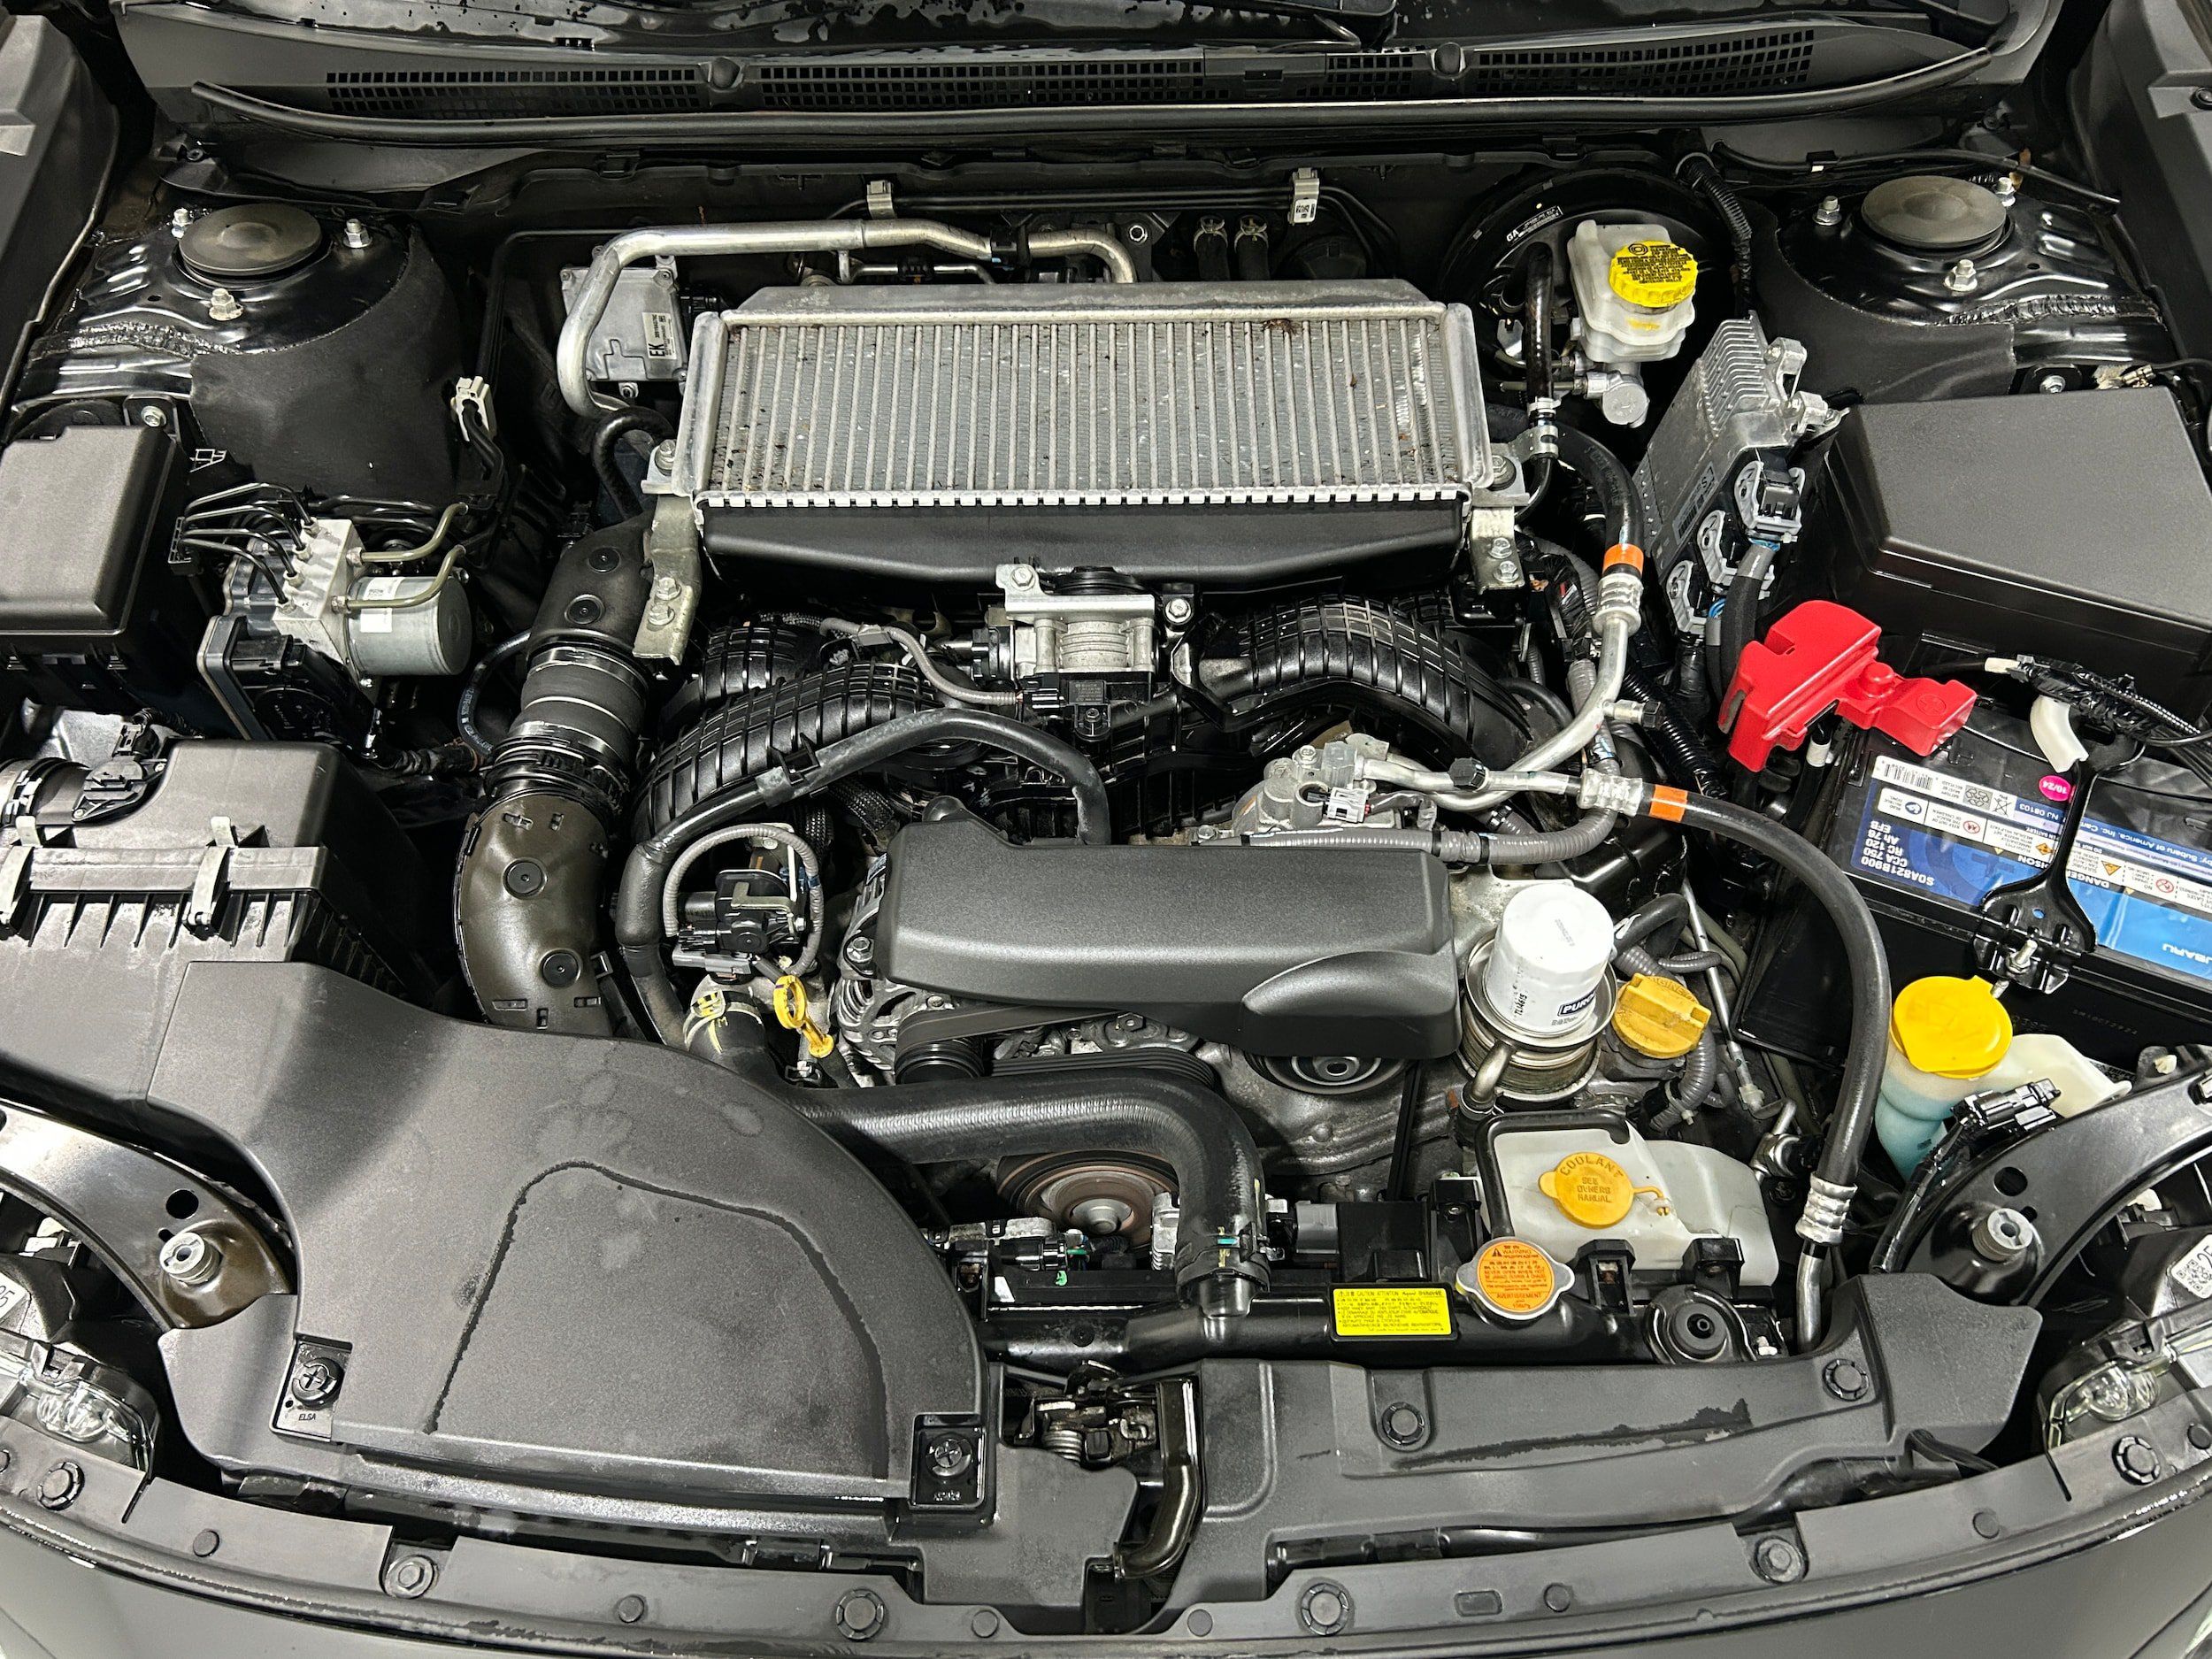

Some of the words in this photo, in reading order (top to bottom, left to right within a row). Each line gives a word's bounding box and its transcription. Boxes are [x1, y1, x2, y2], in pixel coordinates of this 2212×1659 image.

[1507, 229, 1519, 242] GA
[649, 343, 665, 357] EK
[2042, 780, 2068, 795] 10/24
[2019, 803, 2046, 817] 08103
[2047, 811, 2059, 820] NJ
[1870, 820, 1892, 834] EFB
[2101, 827, 2116, 838] Inc.
[1865, 838, 1886, 850] 120
[1883, 833, 1901, 846] Ah
[1863, 847, 1884, 861] 750
[1887, 845, 1903, 856] RC
[2166, 847, 2198, 863] Subaru
[1886, 853, 1908, 868] CCA
[1560, 1154, 1624, 1178] COOLANT
[1581, 1176, 1599, 1185] SEE
[1578, 1193, 1613, 1203] MANUAL
